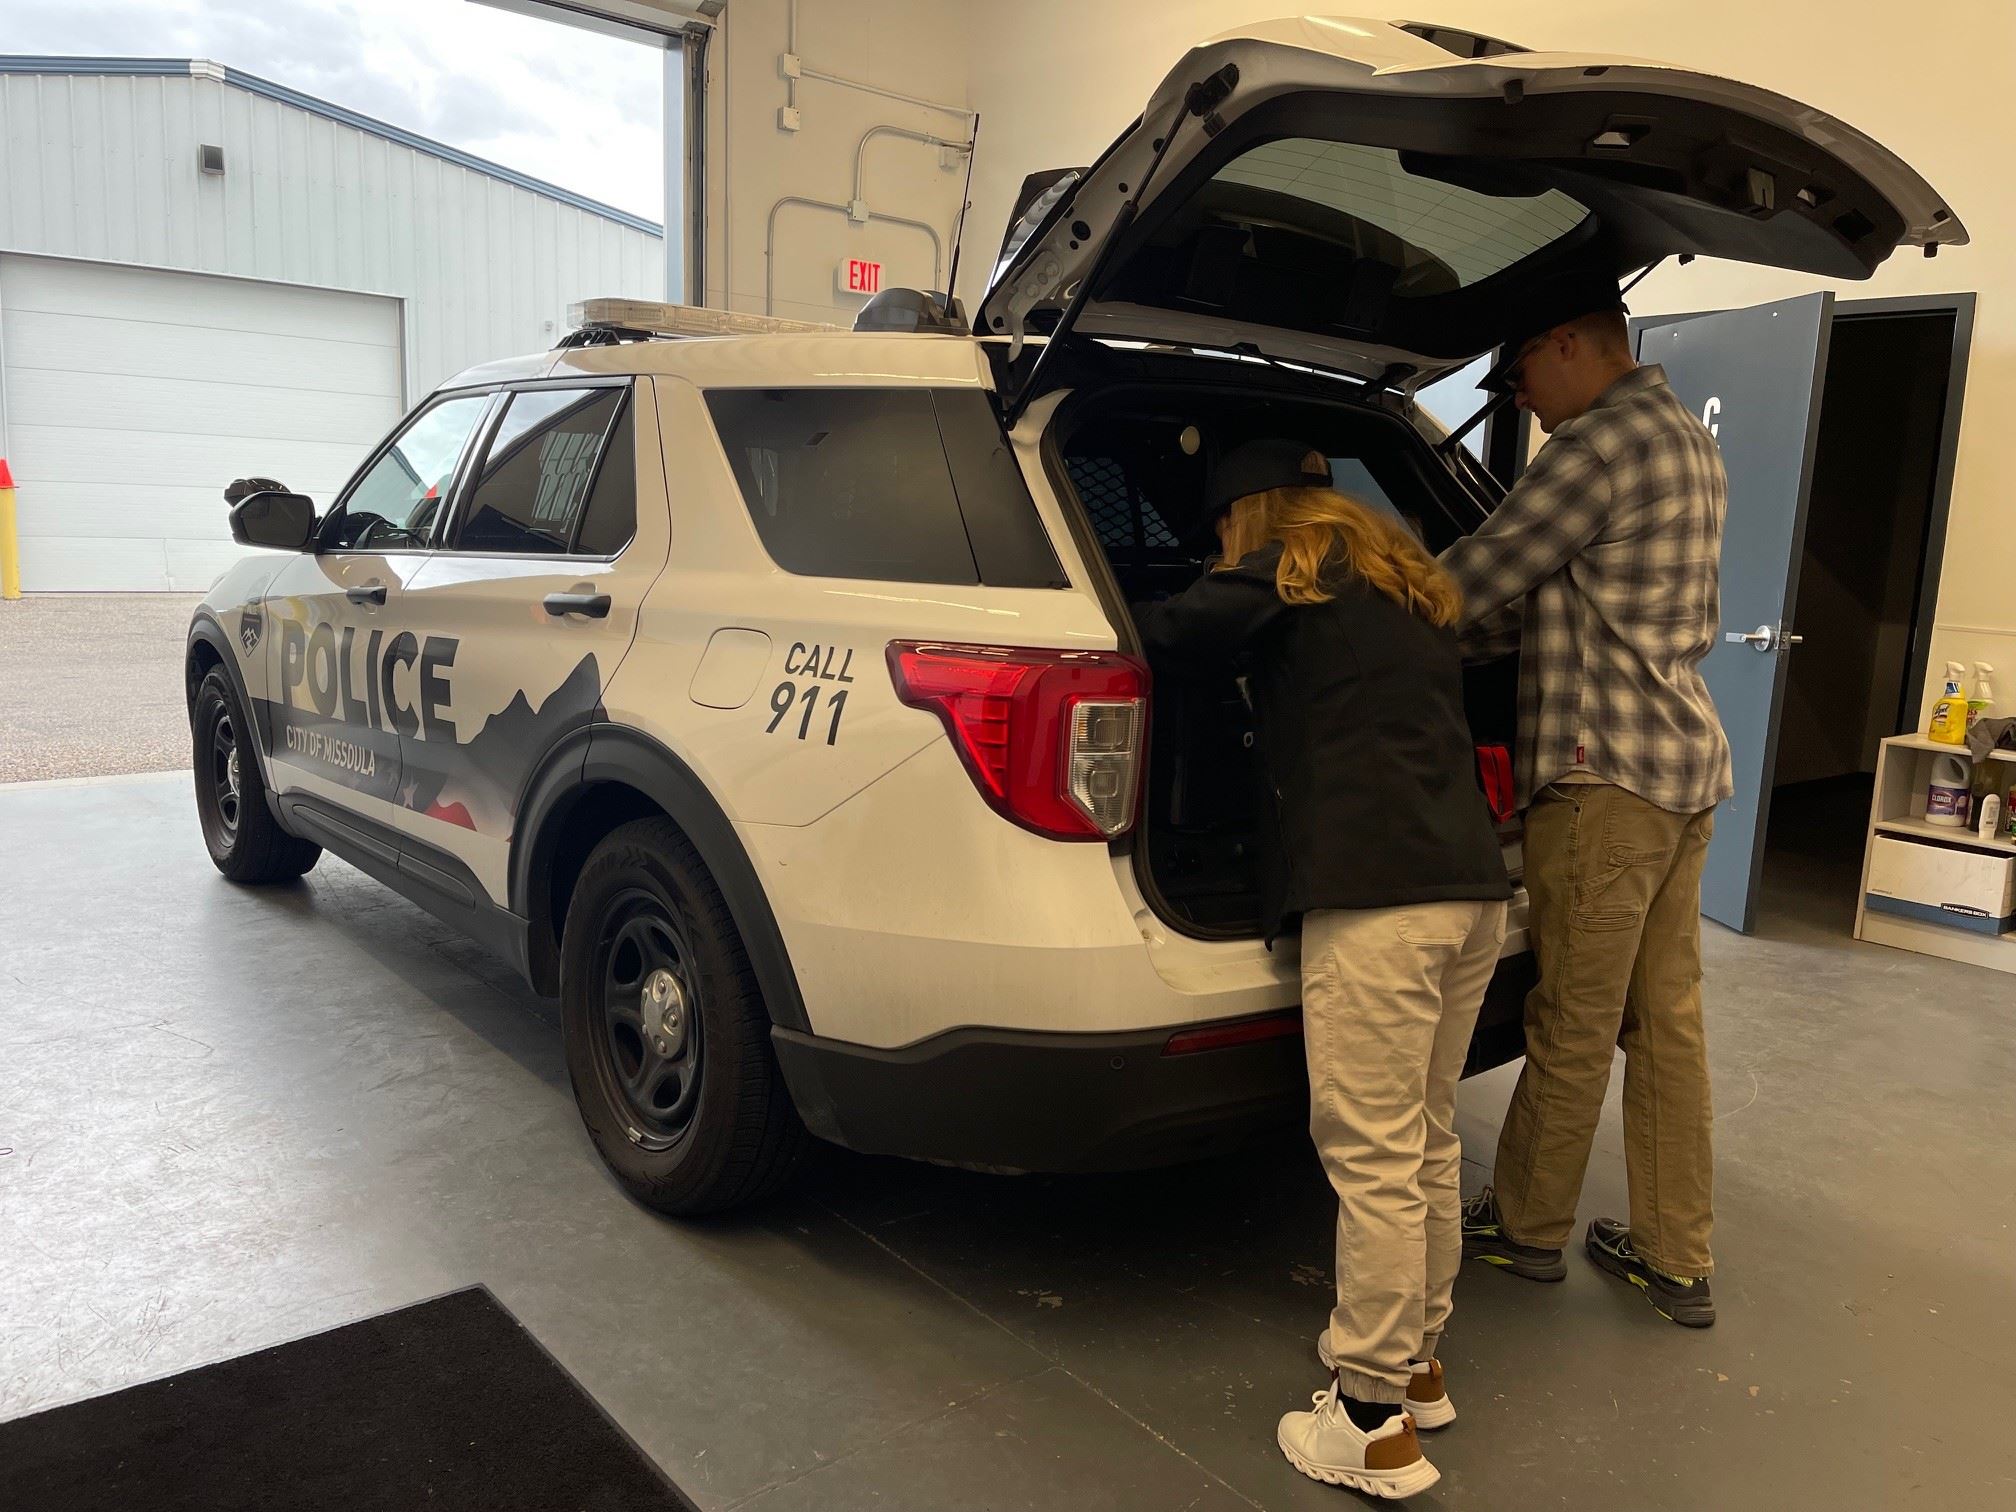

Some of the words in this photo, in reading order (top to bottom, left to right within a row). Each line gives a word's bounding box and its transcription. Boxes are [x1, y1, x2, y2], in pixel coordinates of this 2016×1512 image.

[849, 260, 881, 293] EXIT
[281, 619, 460, 743] POLICE
[785, 642, 854, 683] CALL
[765, 681, 849, 746] 911
[286, 725, 308, 752] CITY
[310, 732, 322, 757] OF
[322, 735, 375, 777] MISSOULA
[1943, 905, 1973, 915] BANKERS
[1973, 910, 1987, 918] BOX
